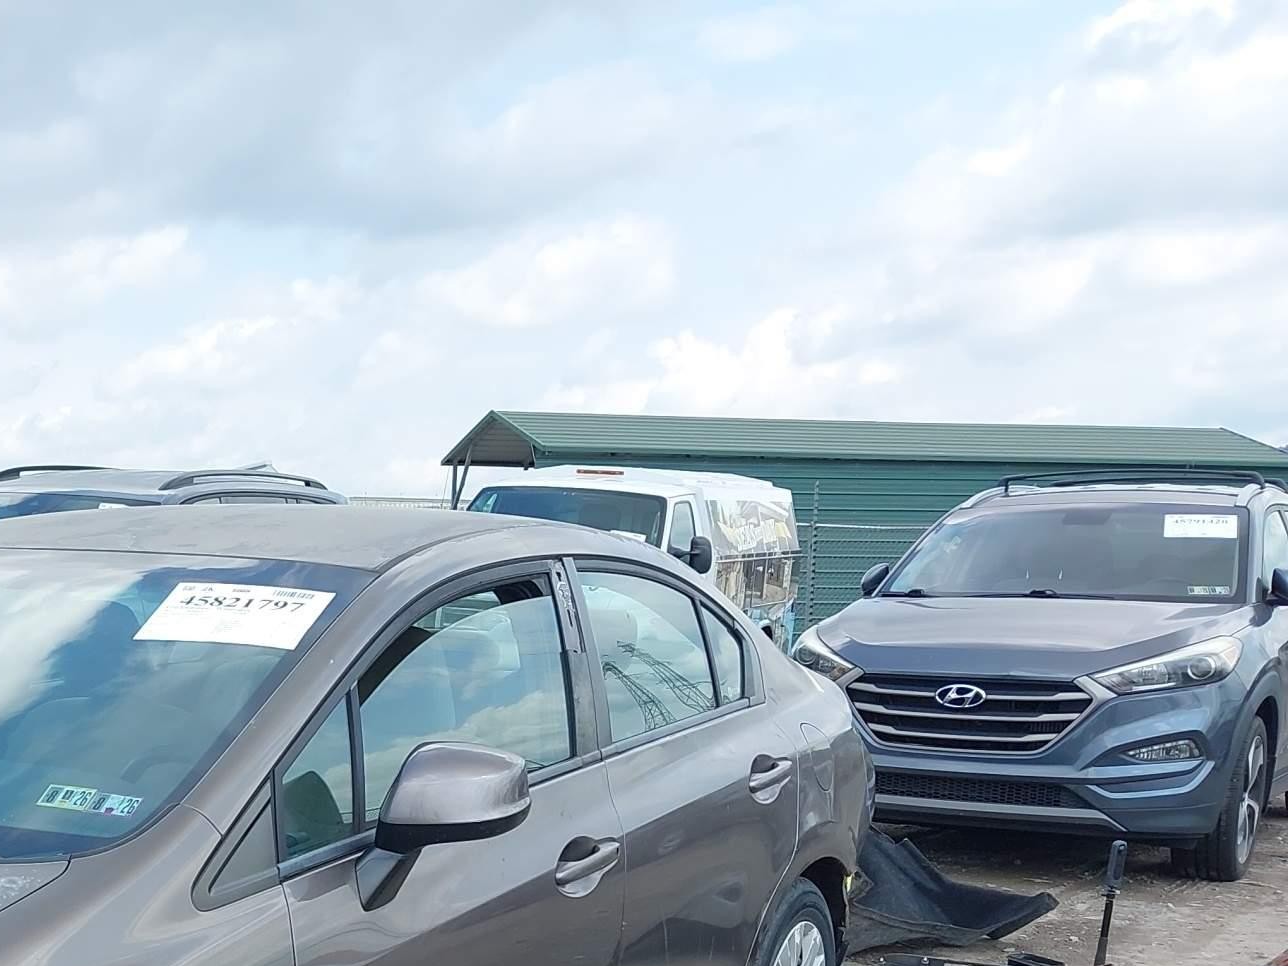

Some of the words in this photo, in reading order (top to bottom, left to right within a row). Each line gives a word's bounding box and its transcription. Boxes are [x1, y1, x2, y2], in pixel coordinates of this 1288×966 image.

[179, 595, 305, 612] 45821797
[73, 790, 92, 806] 26
[119, 797, 140, 814] 26
